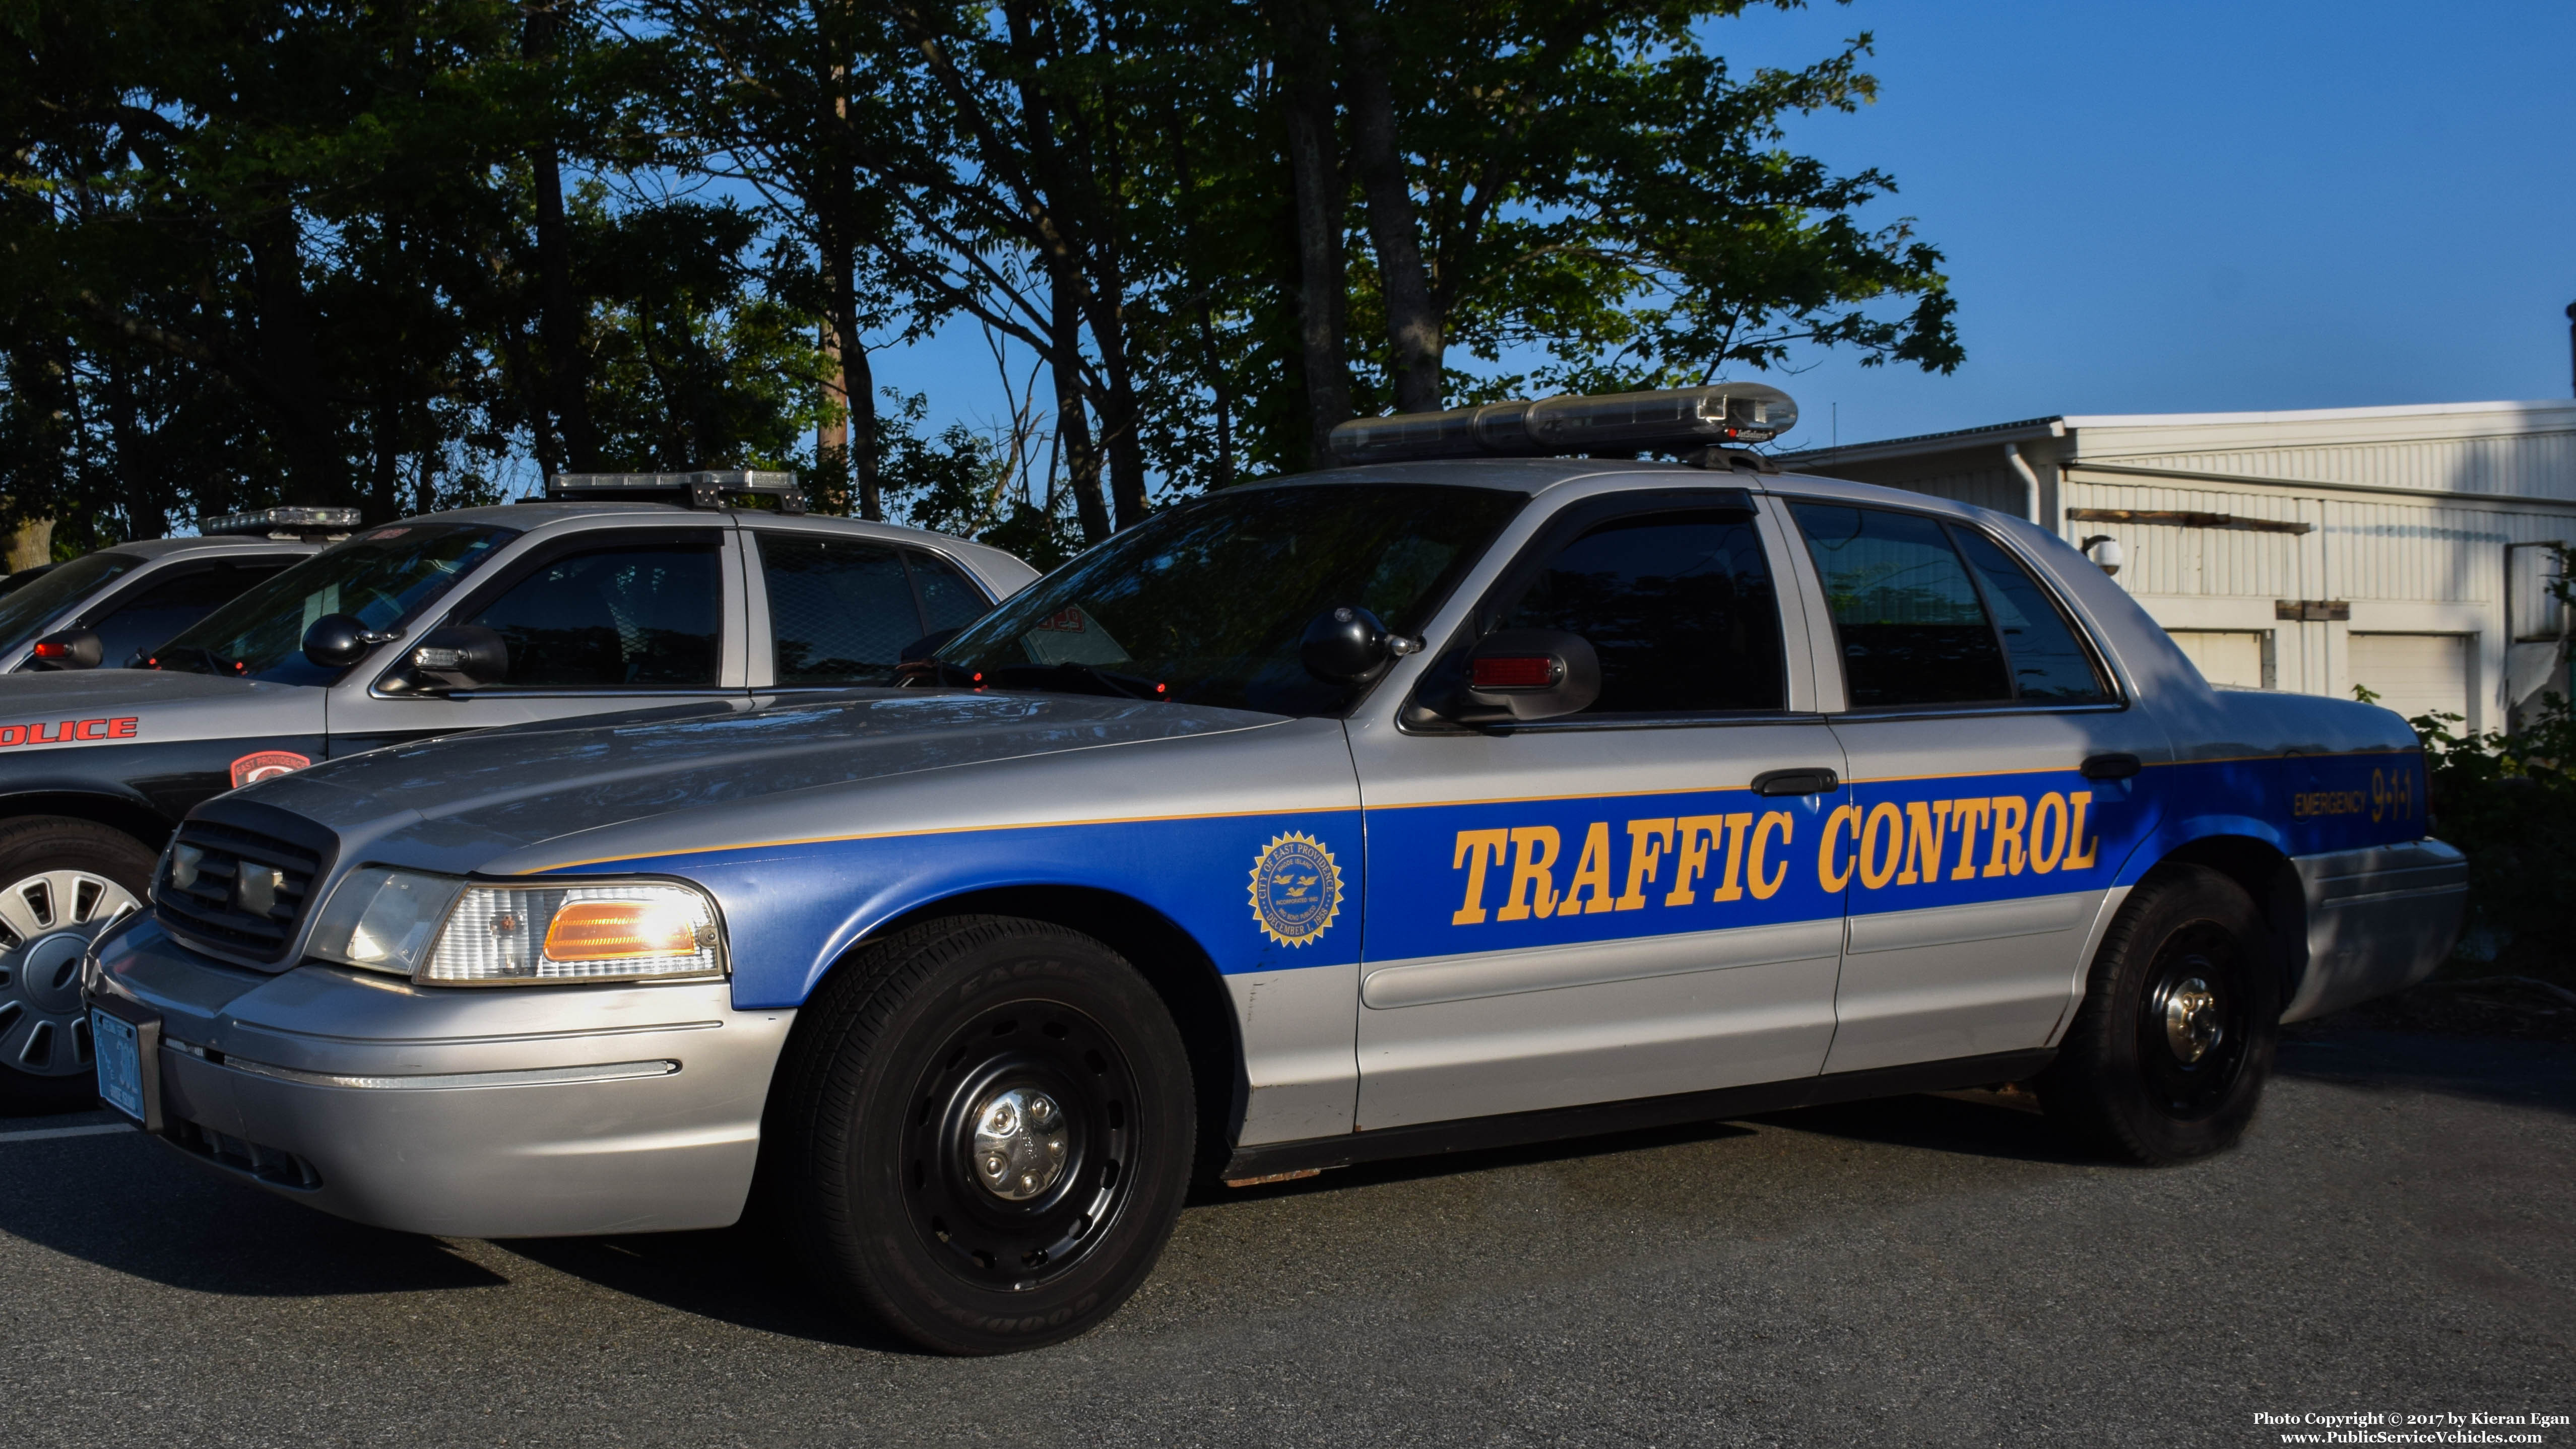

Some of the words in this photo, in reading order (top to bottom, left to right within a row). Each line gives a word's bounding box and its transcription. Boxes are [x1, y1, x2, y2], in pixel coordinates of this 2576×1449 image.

[236, 760, 254, 775] EAST
[2294, 791, 2367, 816] EMERGENCY
[1277, 859, 1294, 873] RHODE
[1295, 858, 1313, 870] ISLAND
[1452, 811, 1793, 926] TRAFFIC
[1819, 792, 2098, 894] CONTROL
[1259, 874, 1267, 899] CITY
[1263, 859, 1274, 872] OF
[1273, 844, 1295, 861] EAST
[1298, 844, 1334, 892] PROVIDENCE
[1276, 897, 1308, 905] INCORPORATED
[1266, 912, 1305, 936] DECEMBER
[1314, 908, 1328, 926] 1958
[1278, 907, 1287, 917] PRO
[1300, 905, 1316, 919] PUBLICO
